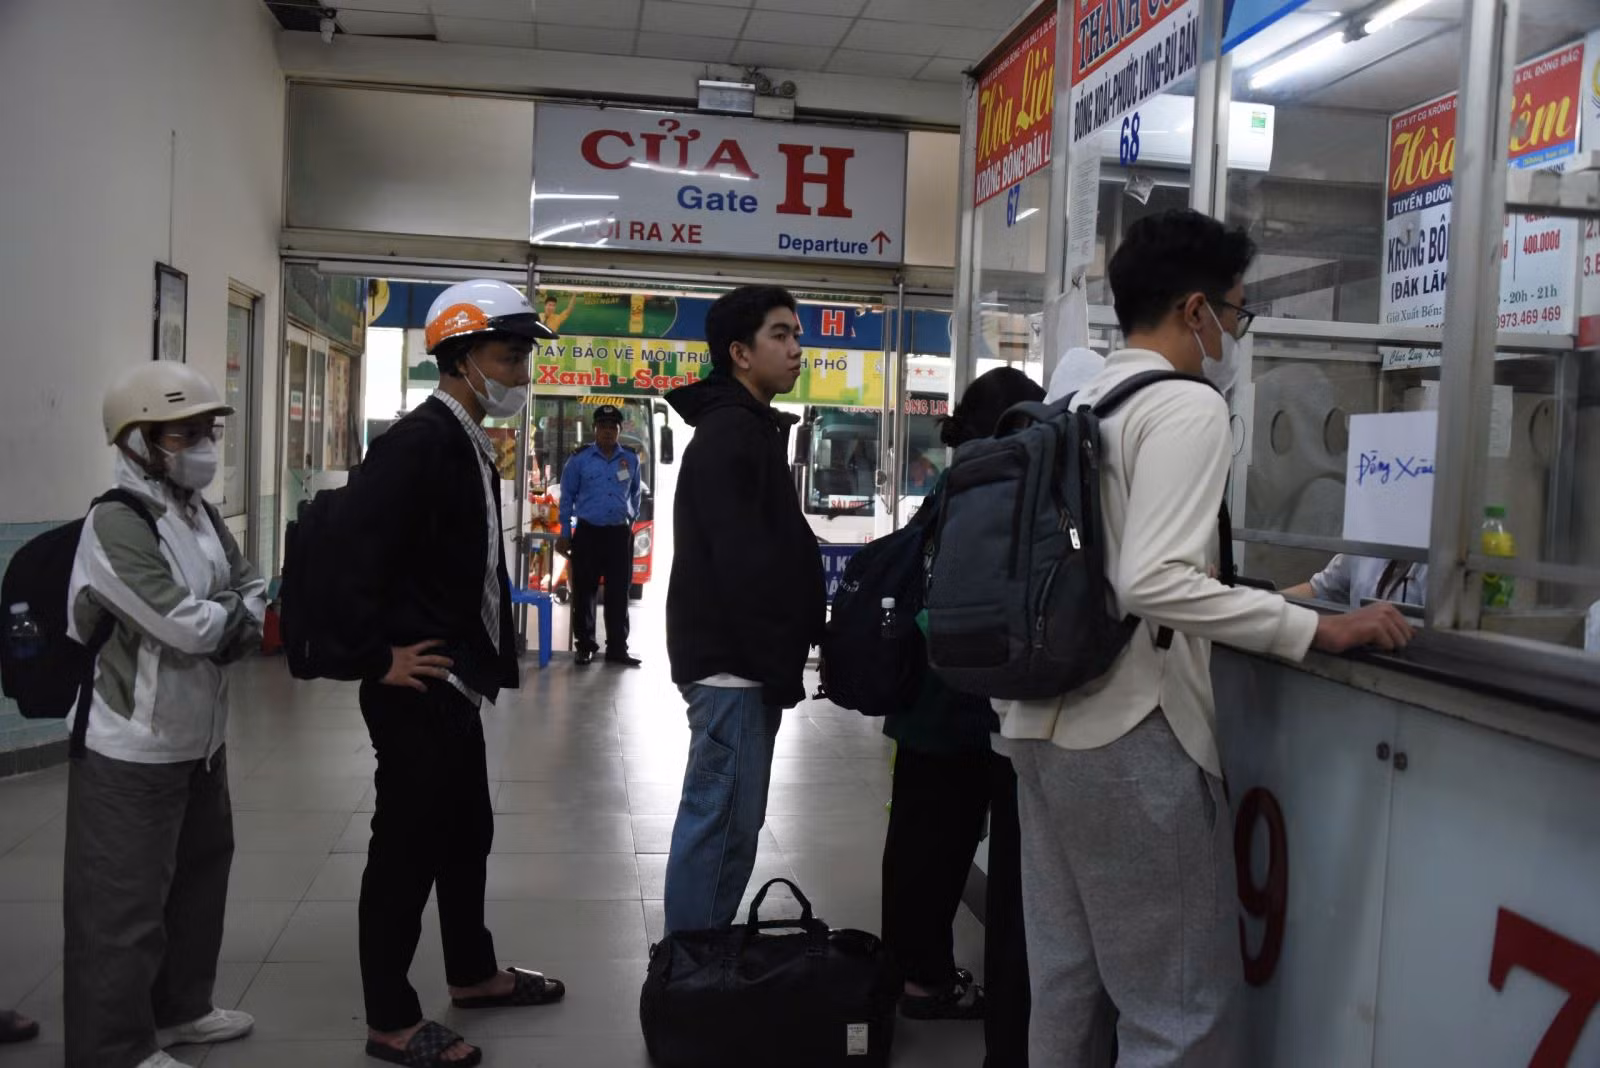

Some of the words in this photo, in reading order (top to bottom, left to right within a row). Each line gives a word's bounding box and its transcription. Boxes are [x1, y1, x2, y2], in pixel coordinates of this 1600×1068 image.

[1509, 92, 1572, 152] êm
[581, 118, 760, 179] CỬA
[1119, 111, 1140, 167] 68
[776, 143, 855, 218] H
[677, 185, 758, 214] Gate
[1006, 183, 1020, 228] 67
[630, 221, 662, 242] RA
[670, 223, 703, 244] XE
[778, 233, 869, 254] Departure
[1509, 289, 1528, 304] 20h
[1536, 284, 1558, 300] 21h
[821, 309, 846, 337] H
[1541, 305, 1561, 322] 469
[537, 365, 611, 387] Xanh
[1487, 905, 1600, 1068] 7
